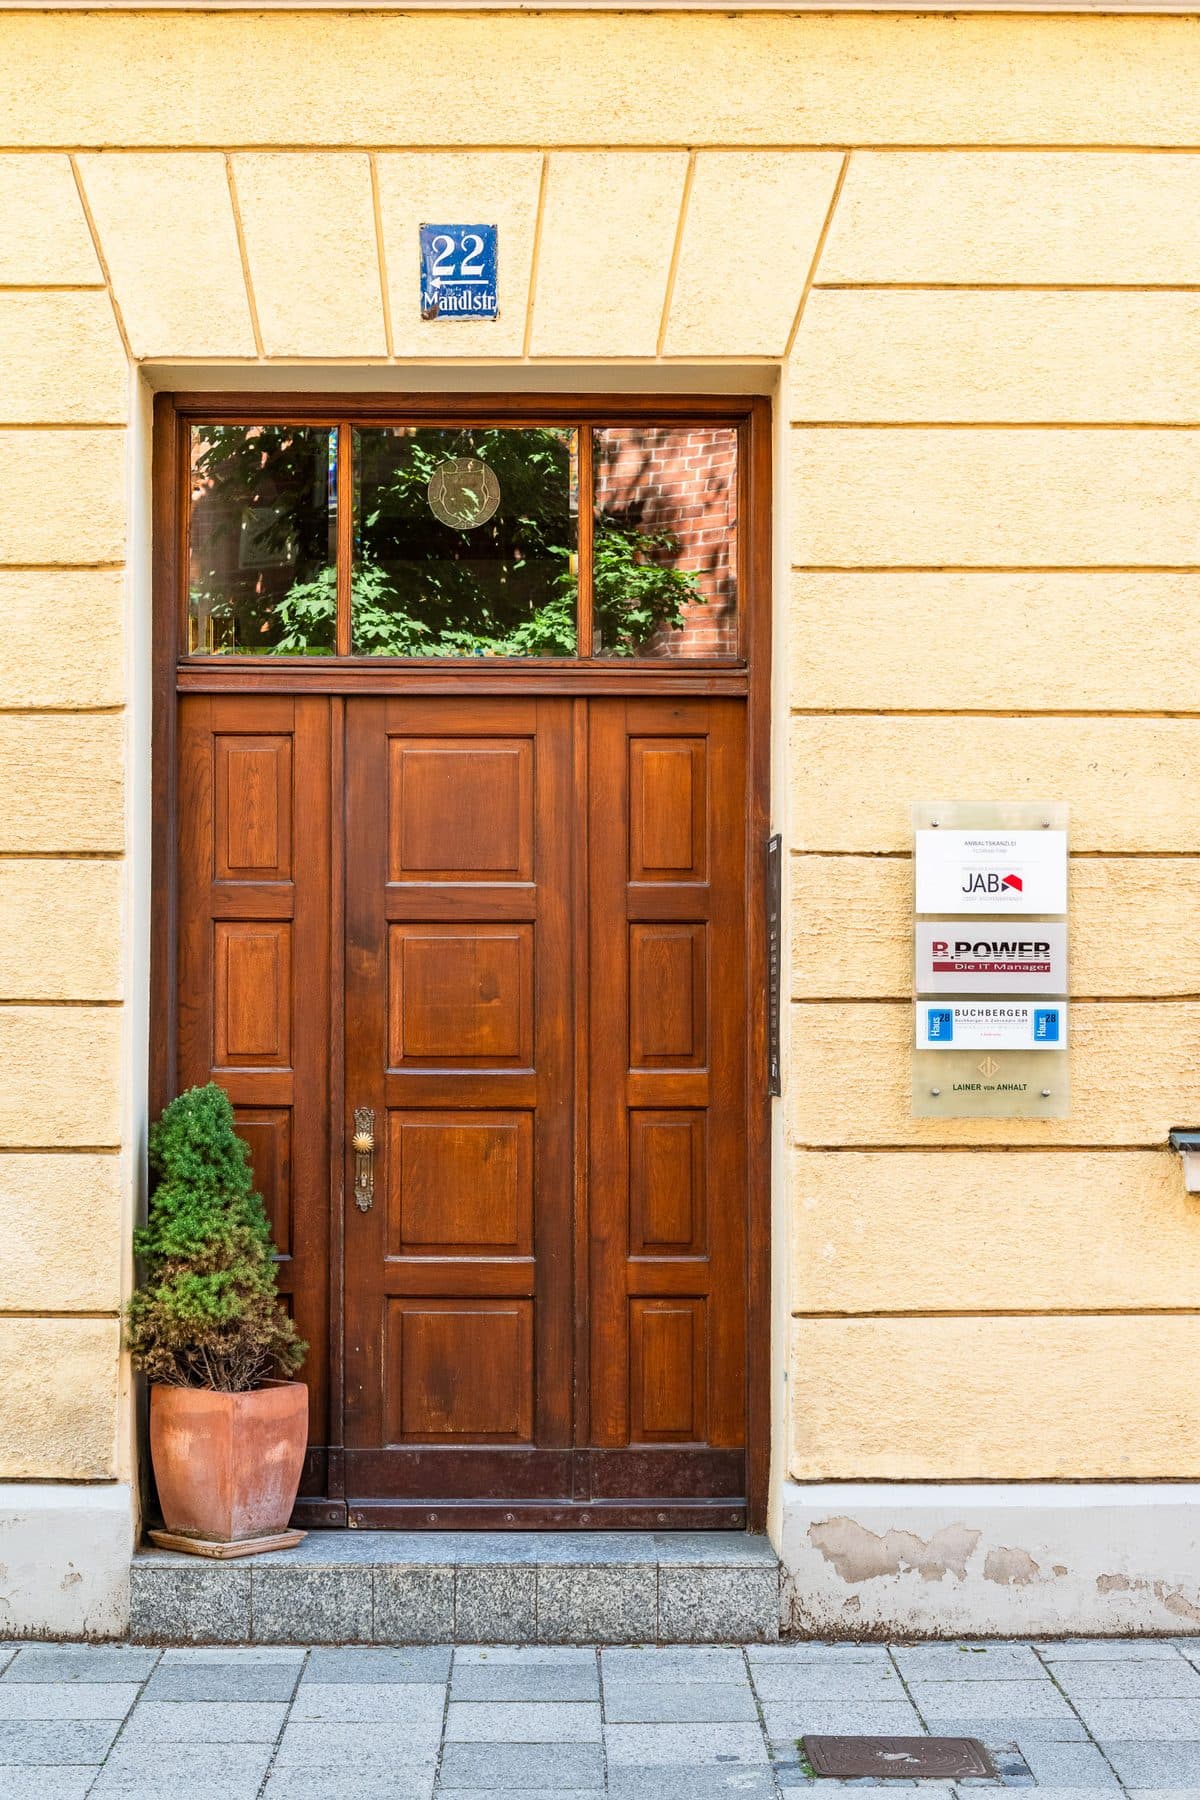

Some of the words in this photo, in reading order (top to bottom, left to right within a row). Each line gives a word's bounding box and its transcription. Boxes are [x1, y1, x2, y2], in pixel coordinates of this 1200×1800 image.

[432, 234, 485, 277] 22
[423, 289, 496, 312] Mandlstr.
[962, 873, 1000, 893] JAB
[994, 963, 1049, 972] Manager
[939, 1013, 950, 1022] 28
[955, 1009, 1028, 1017] BUCHBERGER
[1045, 1014, 1056, 1022] 28
[931, 1017, 940, 1037] Haus
[1037, 1017, 1046, 1037] Haus
[953, 1083, 981, 1091] LAINER
[997, 1083, 1027, 1091] ANHALT
